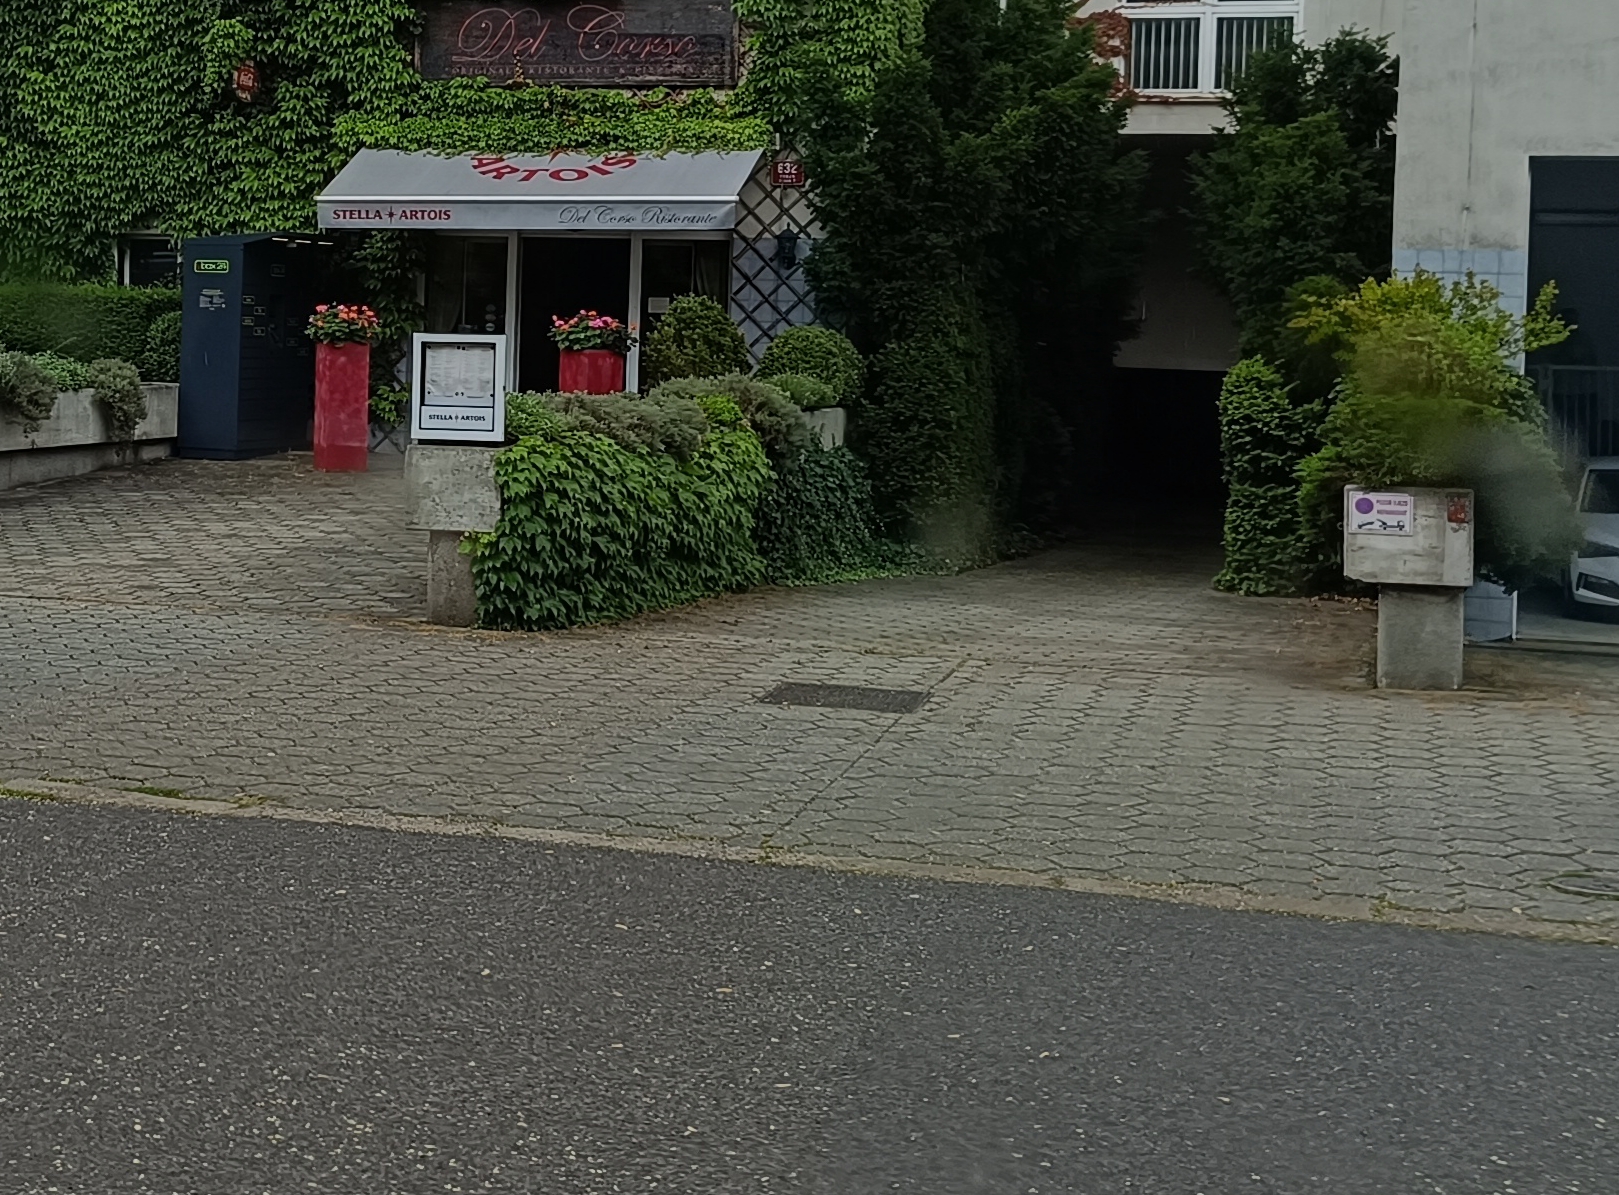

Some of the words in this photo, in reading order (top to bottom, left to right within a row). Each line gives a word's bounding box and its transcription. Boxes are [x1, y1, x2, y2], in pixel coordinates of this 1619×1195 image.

[452, 7, 551, 62] Del
[567, 5, 700, 62] Corso
[471, 153, 638, 182] ARTOIS
[332, 209, 383, 220] STELLA
[398, 209, 451, 221] ARTOIS
[558, 205, 591, 224] Del
[594, 205, 636, 224] Corso
[642, 205, 718, 225] Ristorante
[460, 414, 486, 422] ARTOIS
